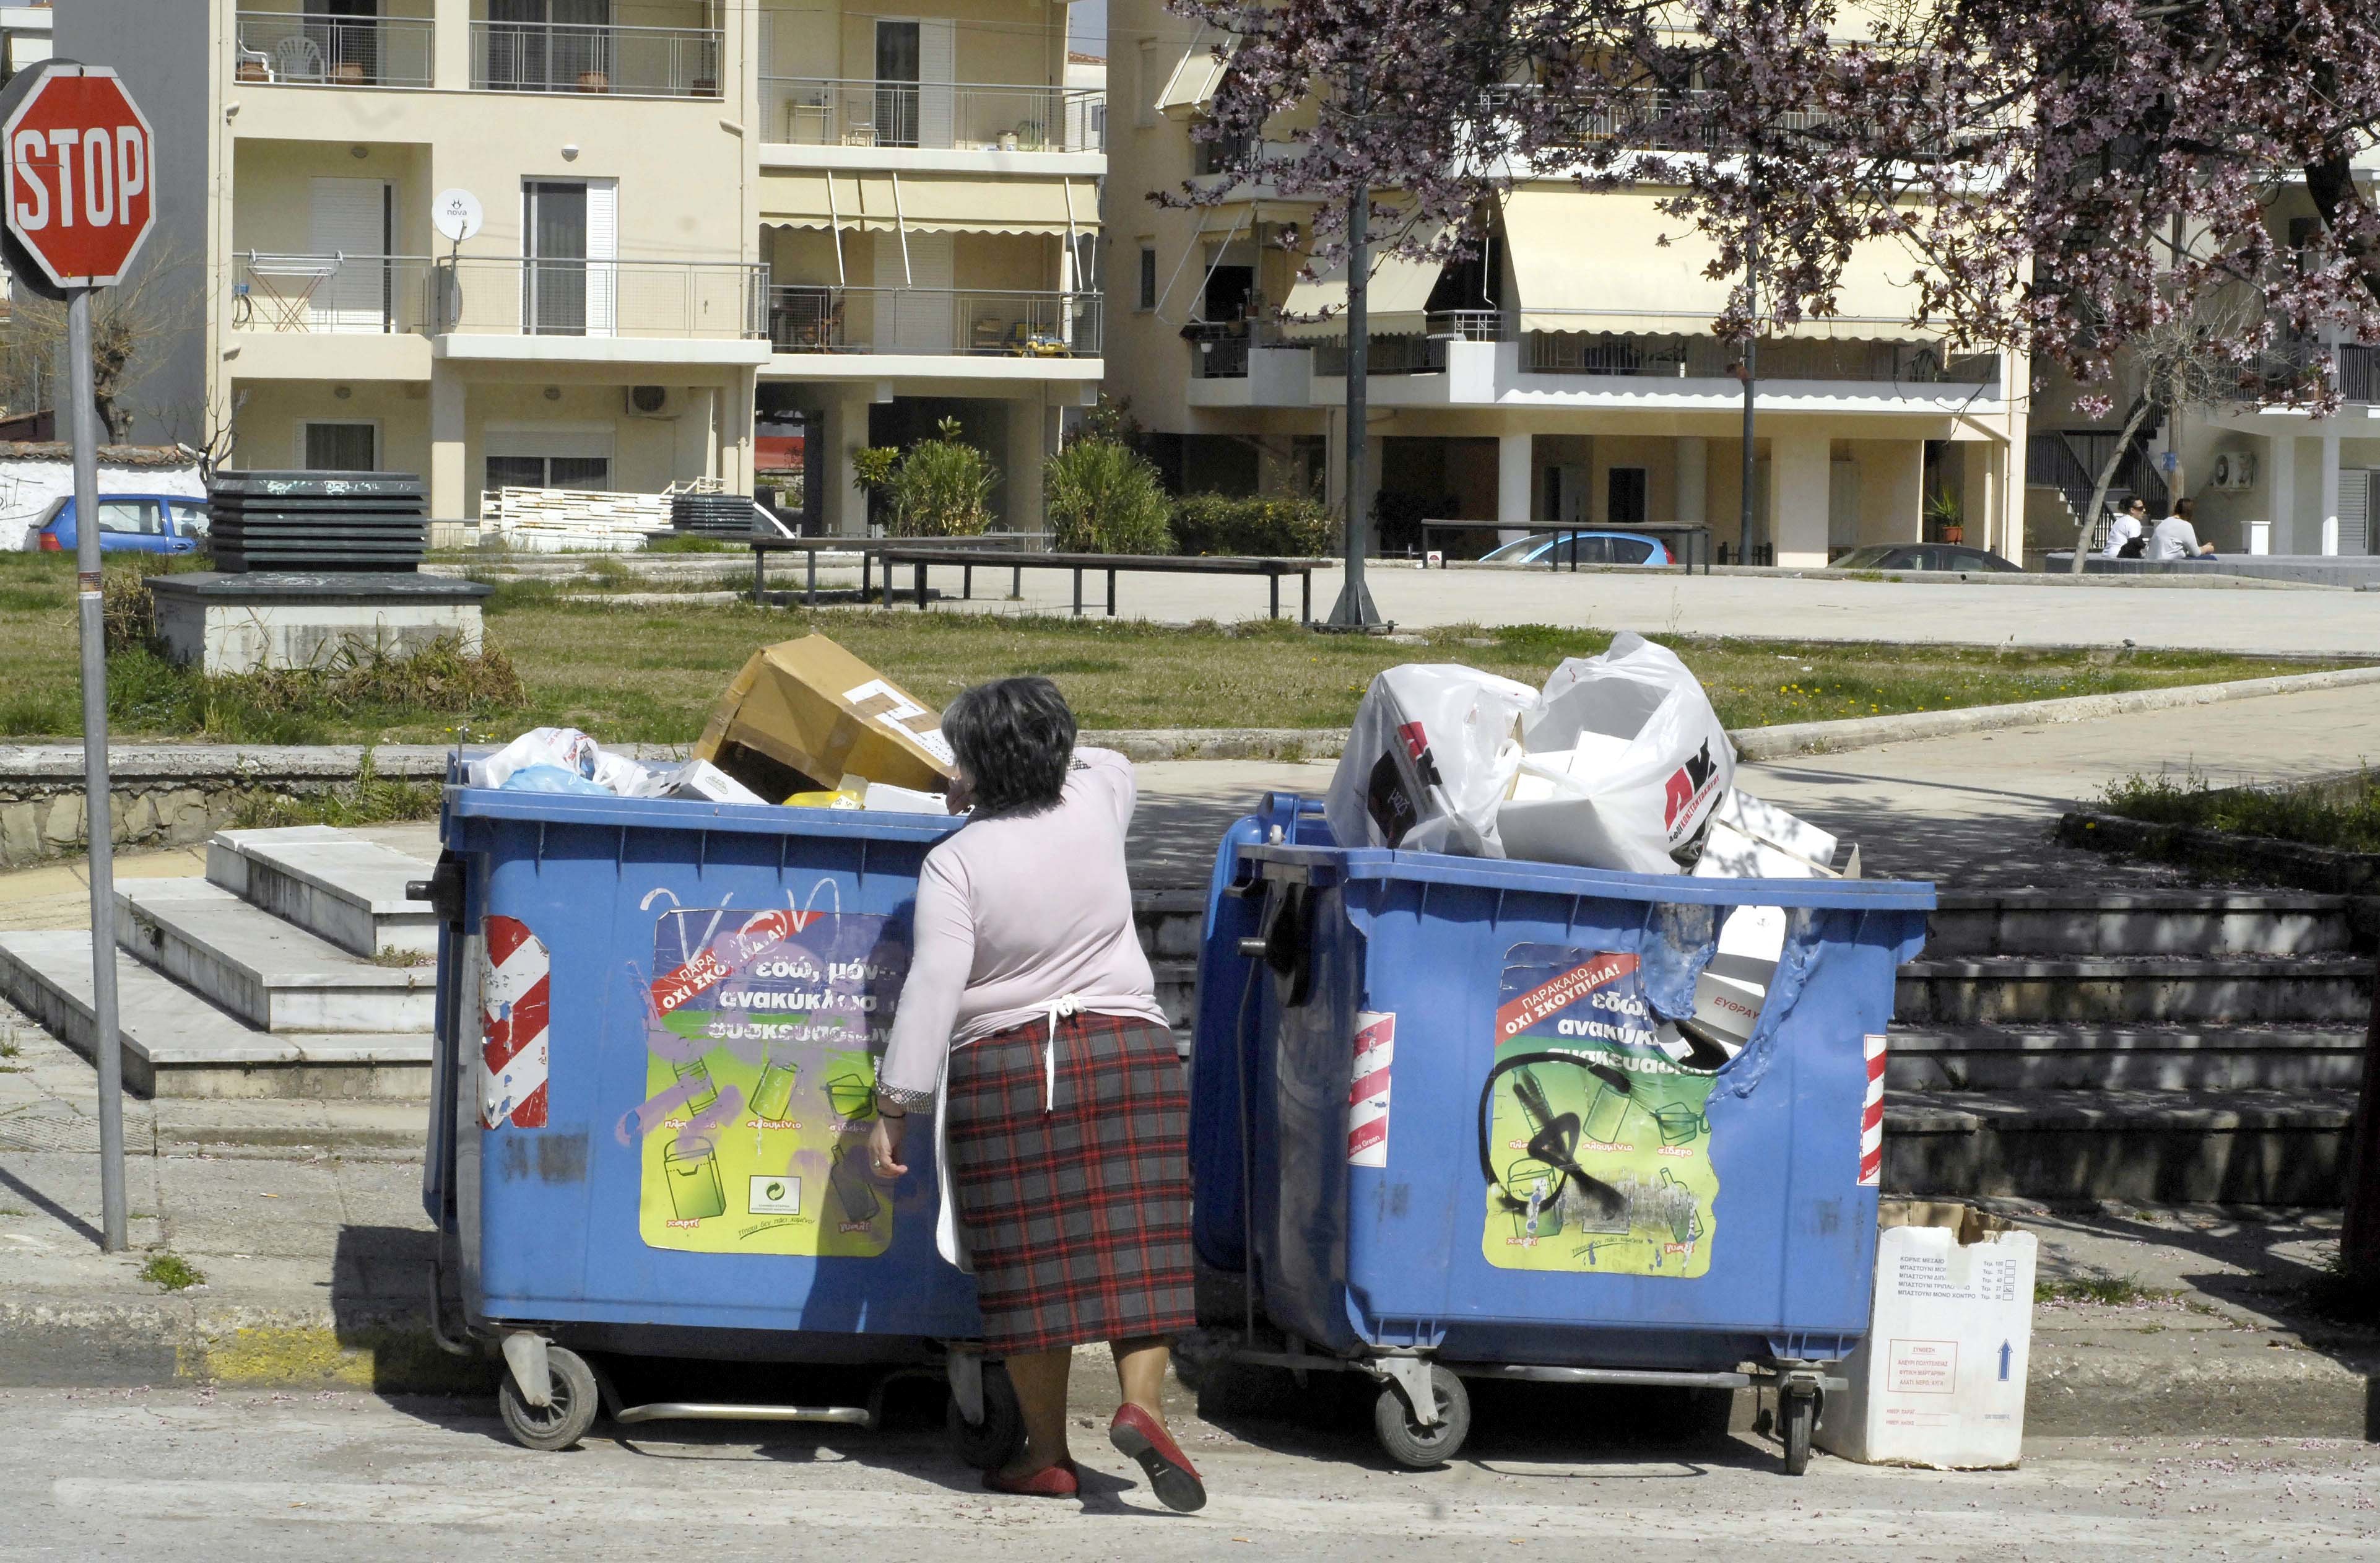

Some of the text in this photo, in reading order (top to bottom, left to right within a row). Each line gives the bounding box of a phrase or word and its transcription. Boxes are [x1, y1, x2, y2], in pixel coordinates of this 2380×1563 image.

[14, 126, 144, 230] STOP
[829, 958, 896, 983] μόν
[662, 985, 692, 1009] ΟΧΙ
[1505, 964, 1620, 1035] ΟΧΙ ΣΚΟΥΠΙΔΙΑ!
[747, 1120, 802, 1130] αλουμίνιο
[1362, 1135, 1380, 1147] Green
[1583, 1143, 1634, 1152] αλουμίνιο
[1657, 1146, 1693, 1157] σίδερο
[667, 1219, 700, 1229] χαρτί
